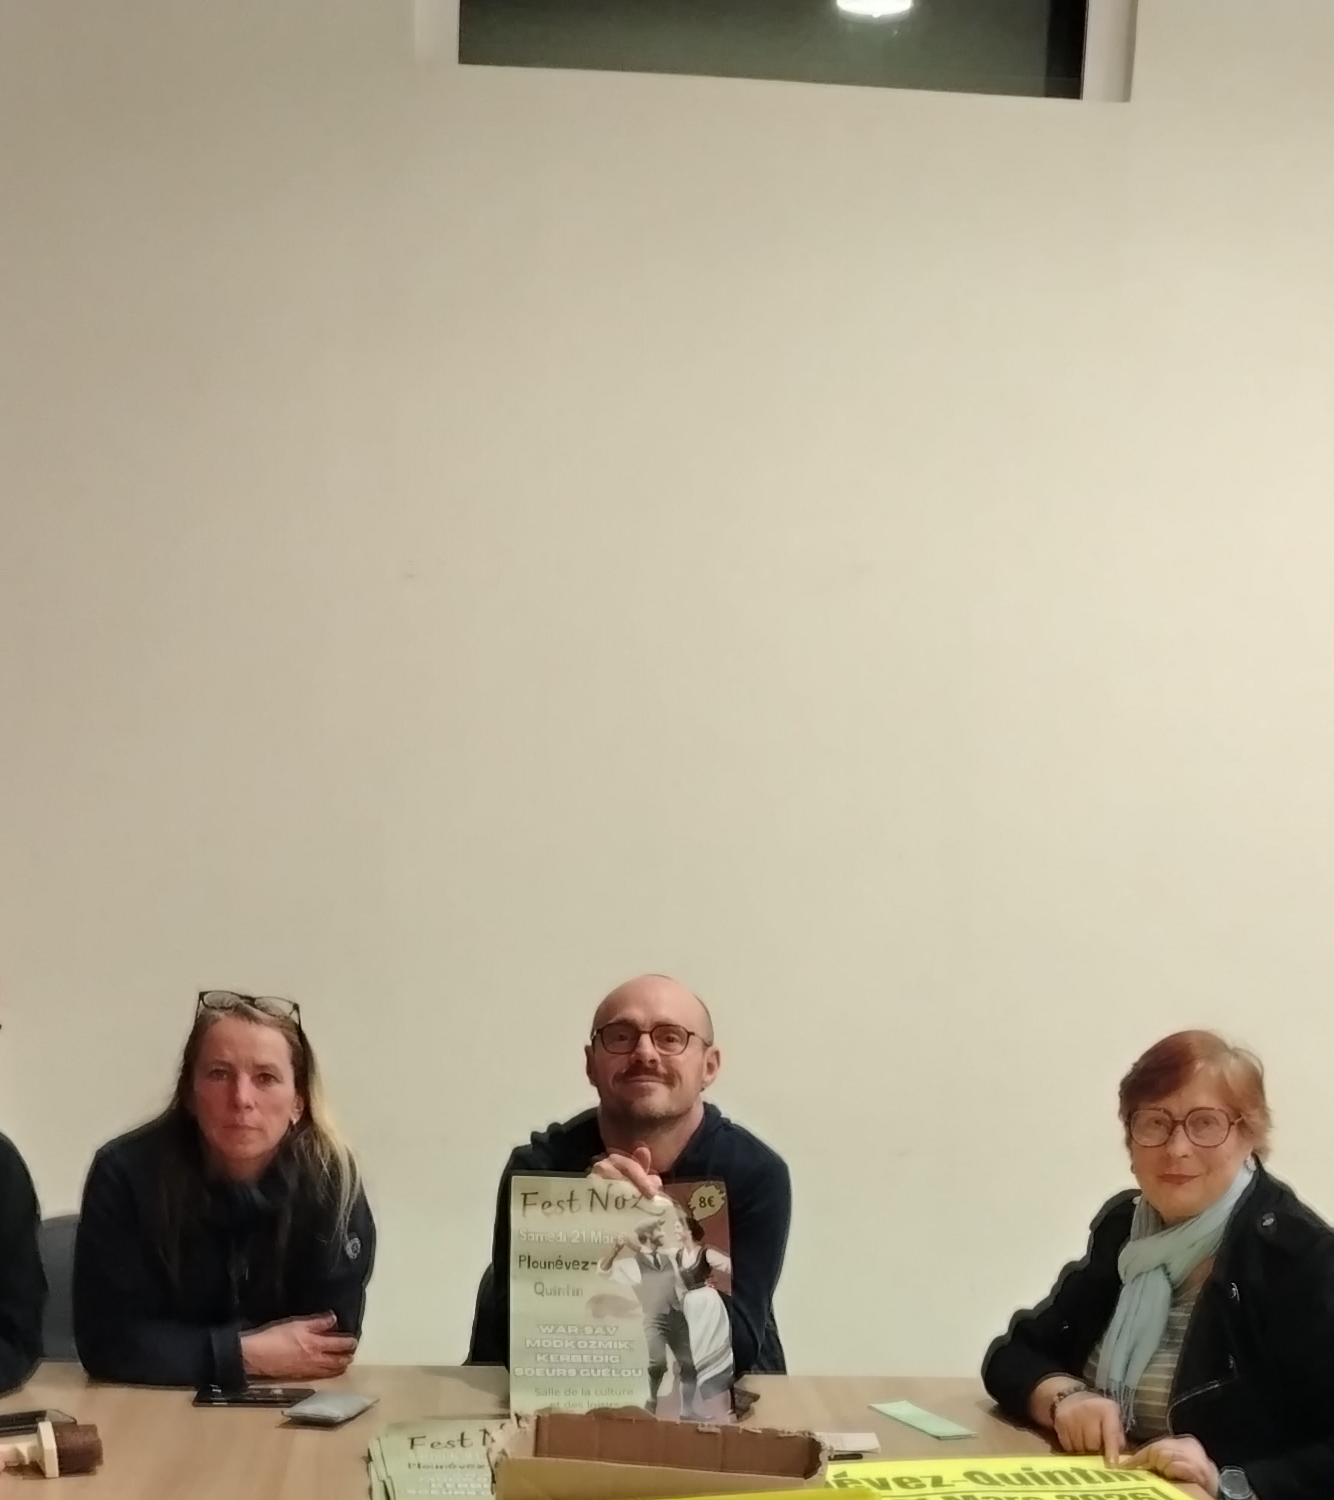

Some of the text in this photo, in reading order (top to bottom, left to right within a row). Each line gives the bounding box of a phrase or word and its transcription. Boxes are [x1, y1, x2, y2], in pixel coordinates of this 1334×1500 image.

[520, 1182, 665, 1217] Fest Noz
[698, 1196, 715, 1208] 8€
[520, 1229, 625, 1245] Samedi 21 Mars
[518, 1255, 598, 1271] Plounévez-
[534, 1281, 584, 1297] Quintin
[525, 1339, 631, 1349] MODKOZMIK
[536, 1354, 620, 1363] KERBEDIG
[514, 1367, 643, 1377] SOEURS GUÉLOU
[534, 1387, 634, 1397] Salle de la culture
[407, 1431, 474, 1450] Fest
[827, 1467, 1147, 1491] évez-Quintin
